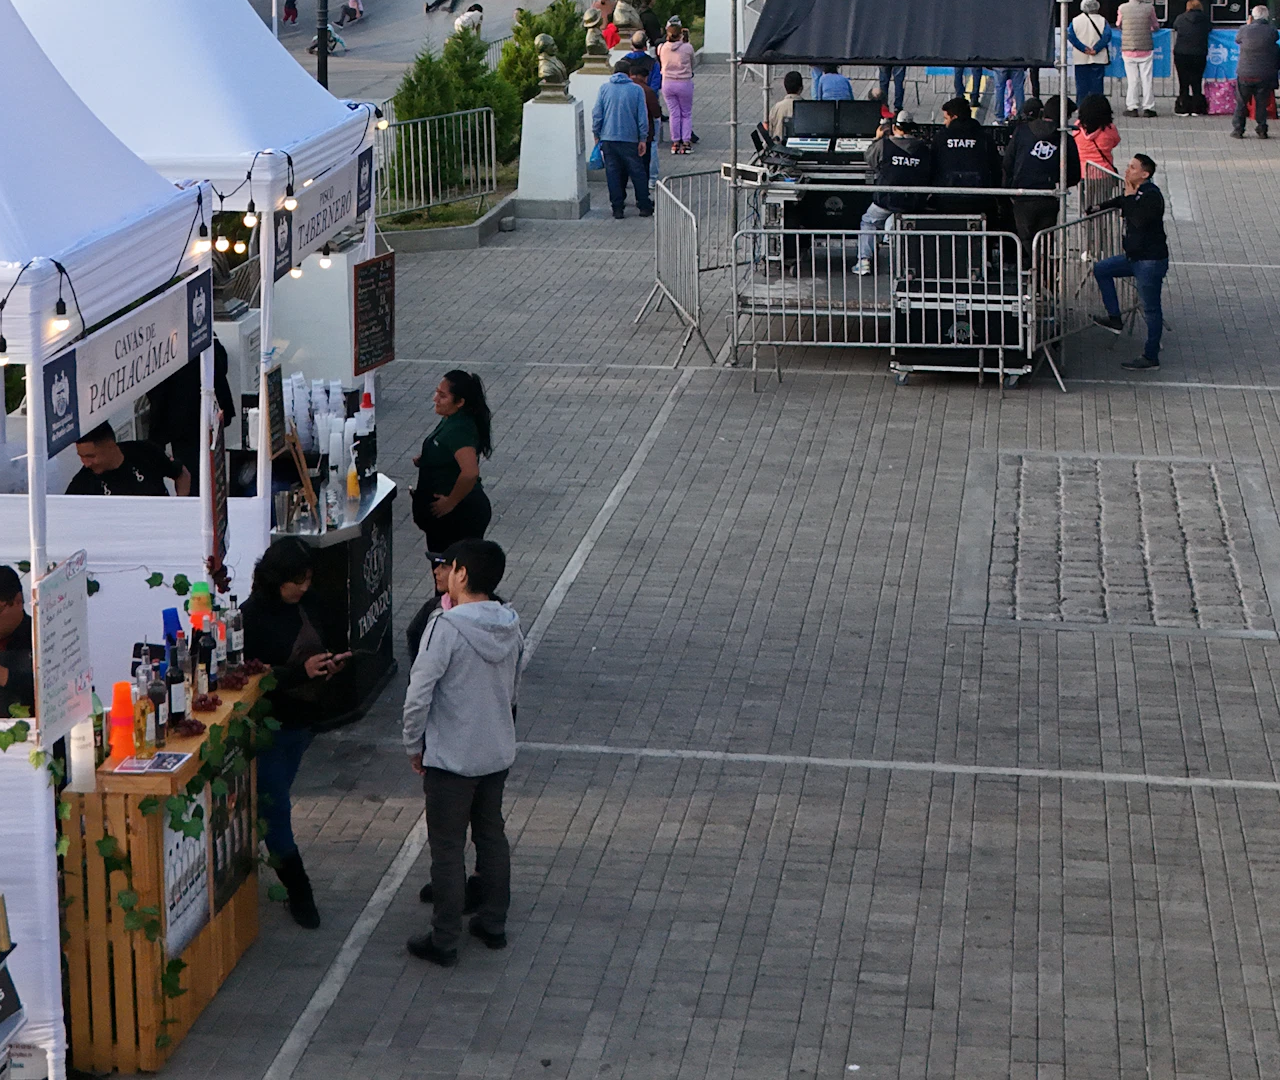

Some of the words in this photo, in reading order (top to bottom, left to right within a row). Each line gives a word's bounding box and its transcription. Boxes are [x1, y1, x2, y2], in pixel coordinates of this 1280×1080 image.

[947, 138, 976, 149] STAFF
[892, 155, 920, 168] STAFF
[320, 186, 334, 206] PISCO
[298, 190, 352, 250] TABERNERO
[114, 326, 144, 360] CAVAS
[145, 323, 157, 343] DE
[89, 332, 178, 414] PACHACÁMAC
